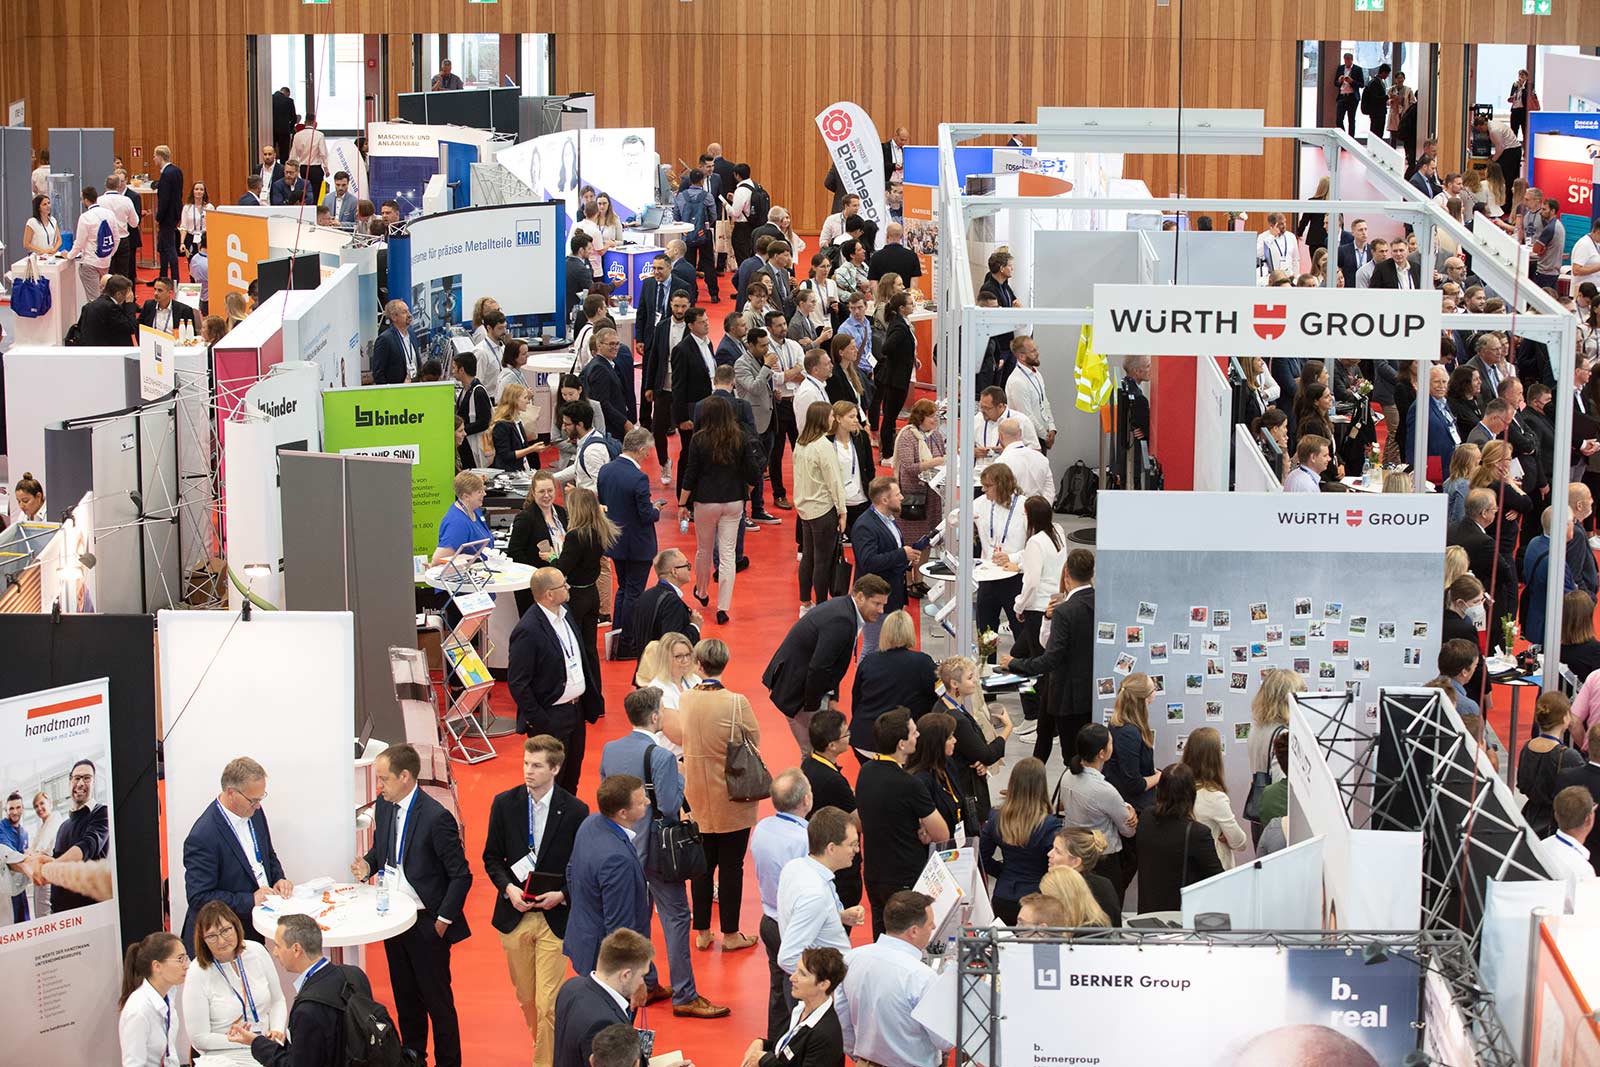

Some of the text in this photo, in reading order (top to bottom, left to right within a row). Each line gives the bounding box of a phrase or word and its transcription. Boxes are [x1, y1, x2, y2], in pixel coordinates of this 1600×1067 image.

[1567, 184, 1592, 205] SP
[428, 246, 437, 260] für
[437, 243, 463, 260] präzise
[464, 236, 512, 253] Metallteile
[517, 230, 540, 246] EMAG
[226, 233, 250, 303] PP
[1110, 308, 1425, 338] WÜRTH GROUP
[374, 408, 425, 427] binder
[1278, 512, 1430, 526] WÜRTH GROUP
[25, 714, 90, 737] handtmann
[26, 922, 58, 939] STARK
[60, 916, 83, 930] SEIN
[1070, 974, 1191, 992] BERNER Group
[1331, 976, 1359, 1000] b.
[1331, 1004, 1388, 1028] real
[1034, 1043, 1044, 1052] b.
[1034, 1054, 1101, 1065] bernergroup
